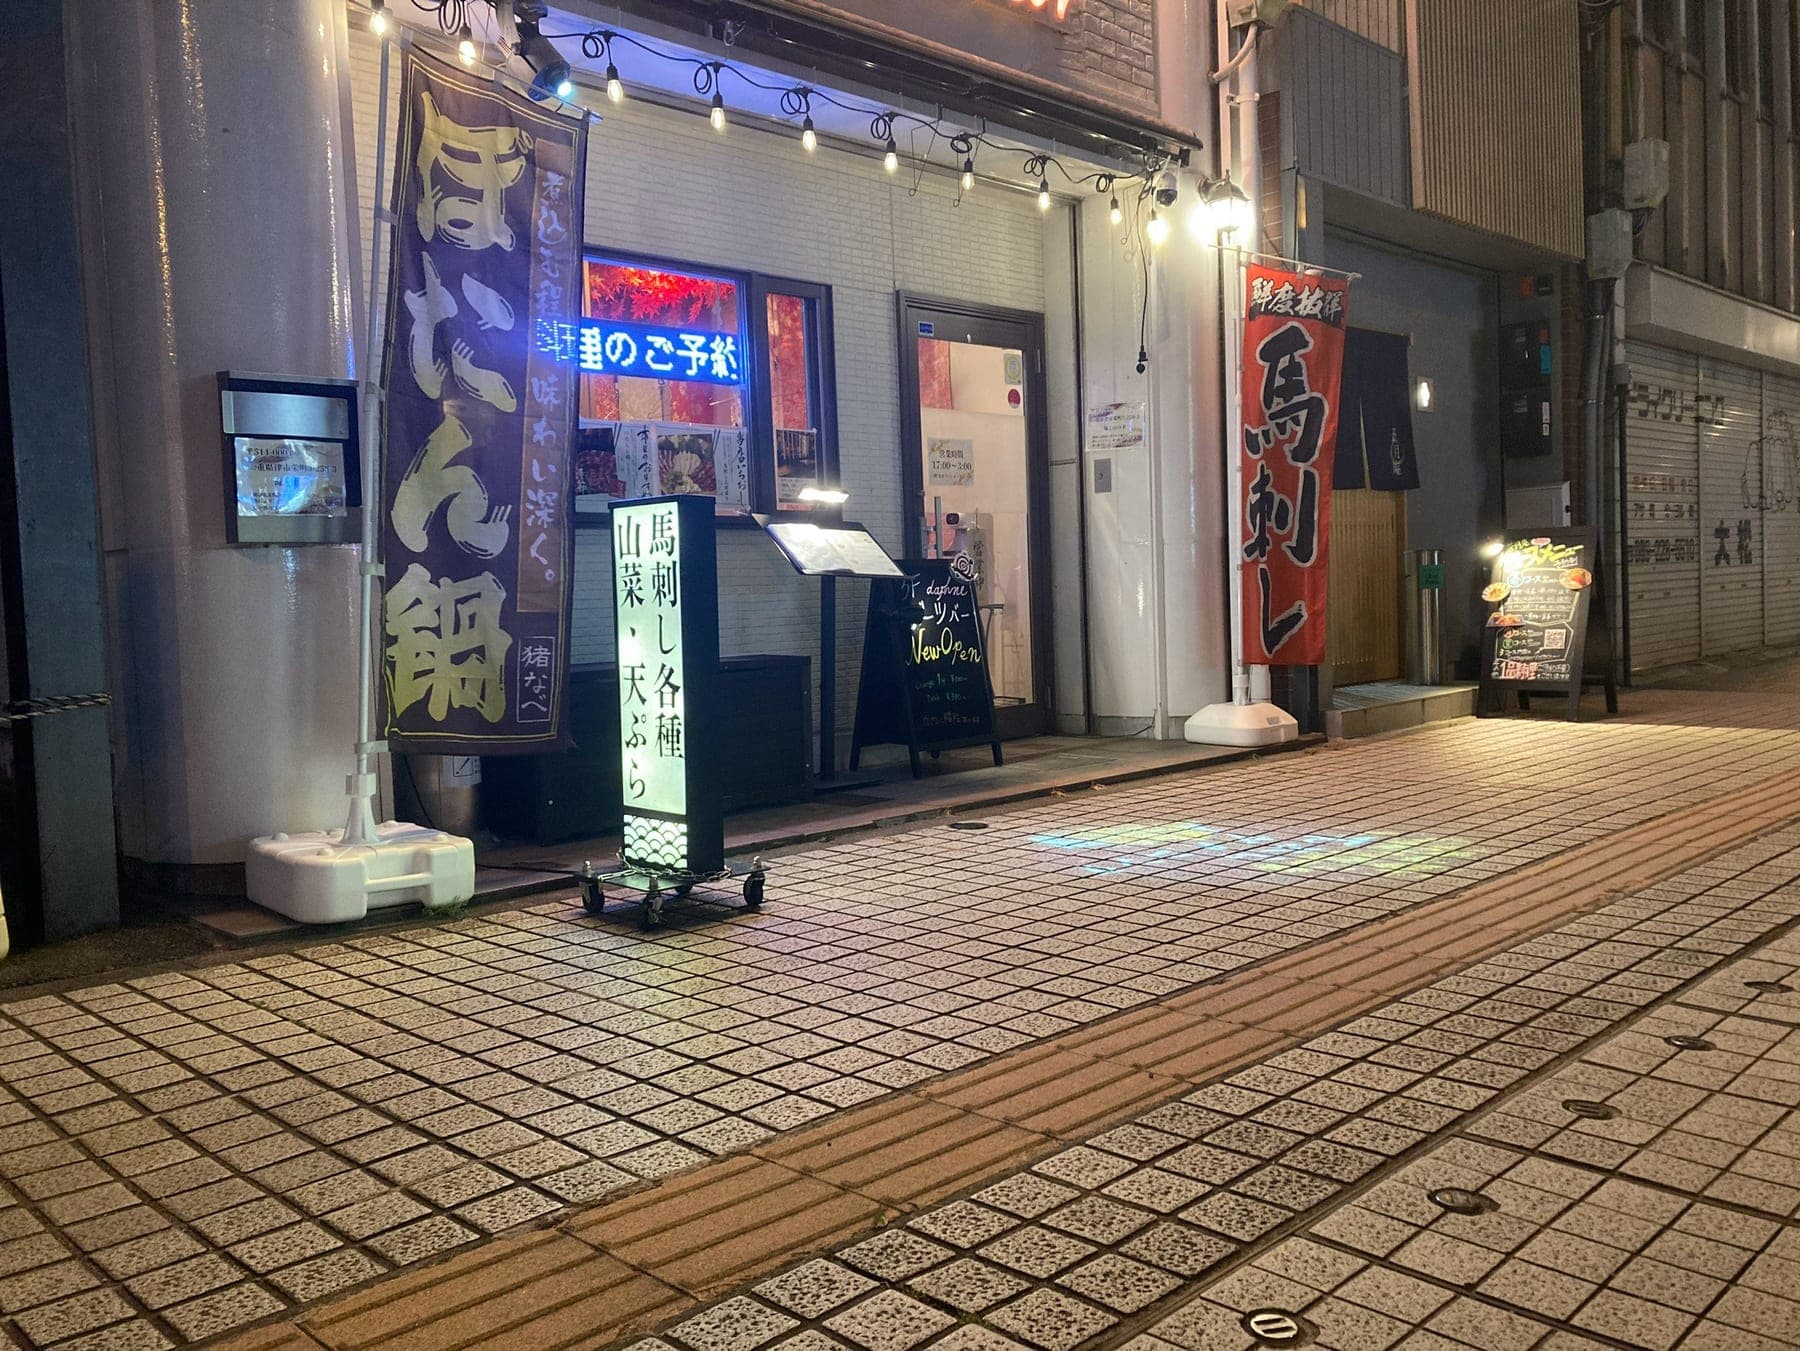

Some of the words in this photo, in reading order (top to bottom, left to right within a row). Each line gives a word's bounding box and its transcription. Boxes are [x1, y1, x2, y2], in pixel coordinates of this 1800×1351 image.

[385, 91, 534, 724] ぼたん鍋
[1243, 323, 1329, 660] 馬刺し
[521, 645, 551, 714] 猪なべ
[649, 509, 685, 759] 馬刺し各種
